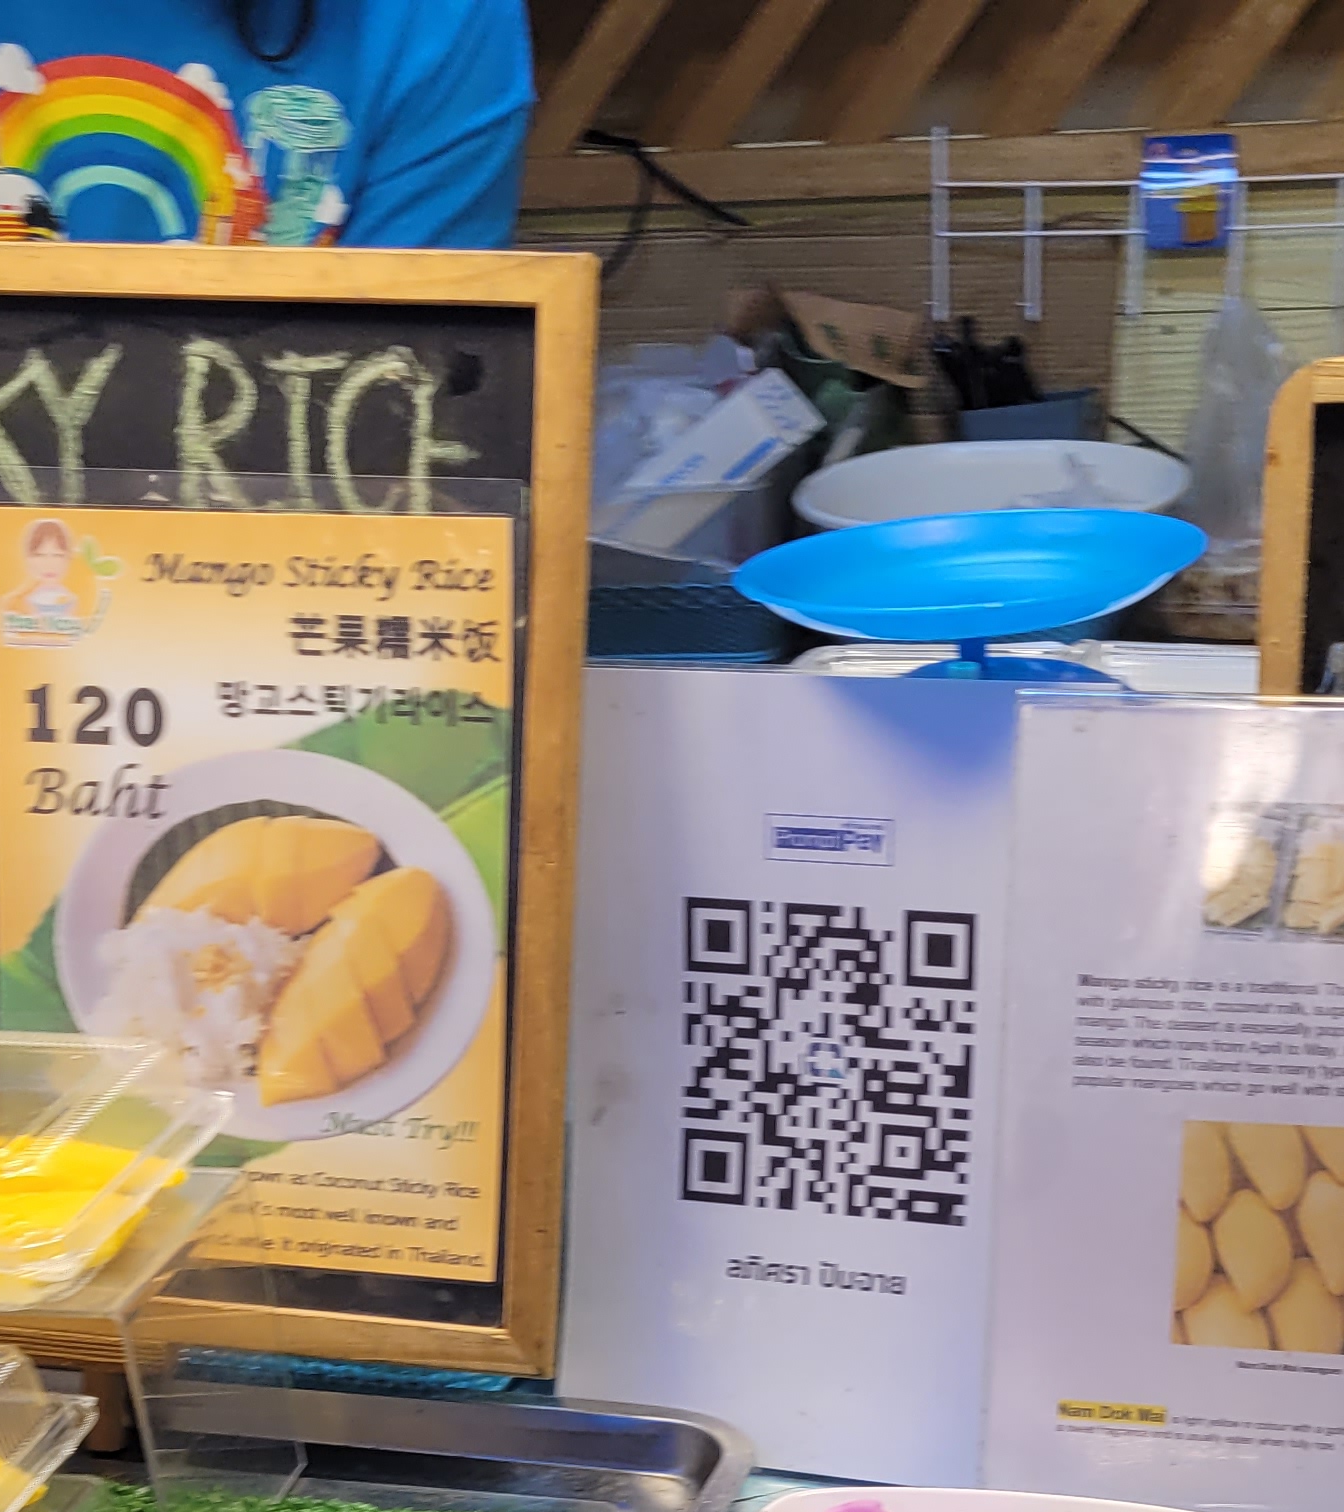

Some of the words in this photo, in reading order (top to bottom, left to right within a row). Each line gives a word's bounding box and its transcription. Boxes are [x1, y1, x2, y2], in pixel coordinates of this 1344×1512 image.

[140, 553, 276, 597] Mango
[283, 553, 400, 600] Sticky
[410, 558, 495, 593] Rice
[26, 683, 164, 748] 120
[24, 764, 172, 820] Baht
